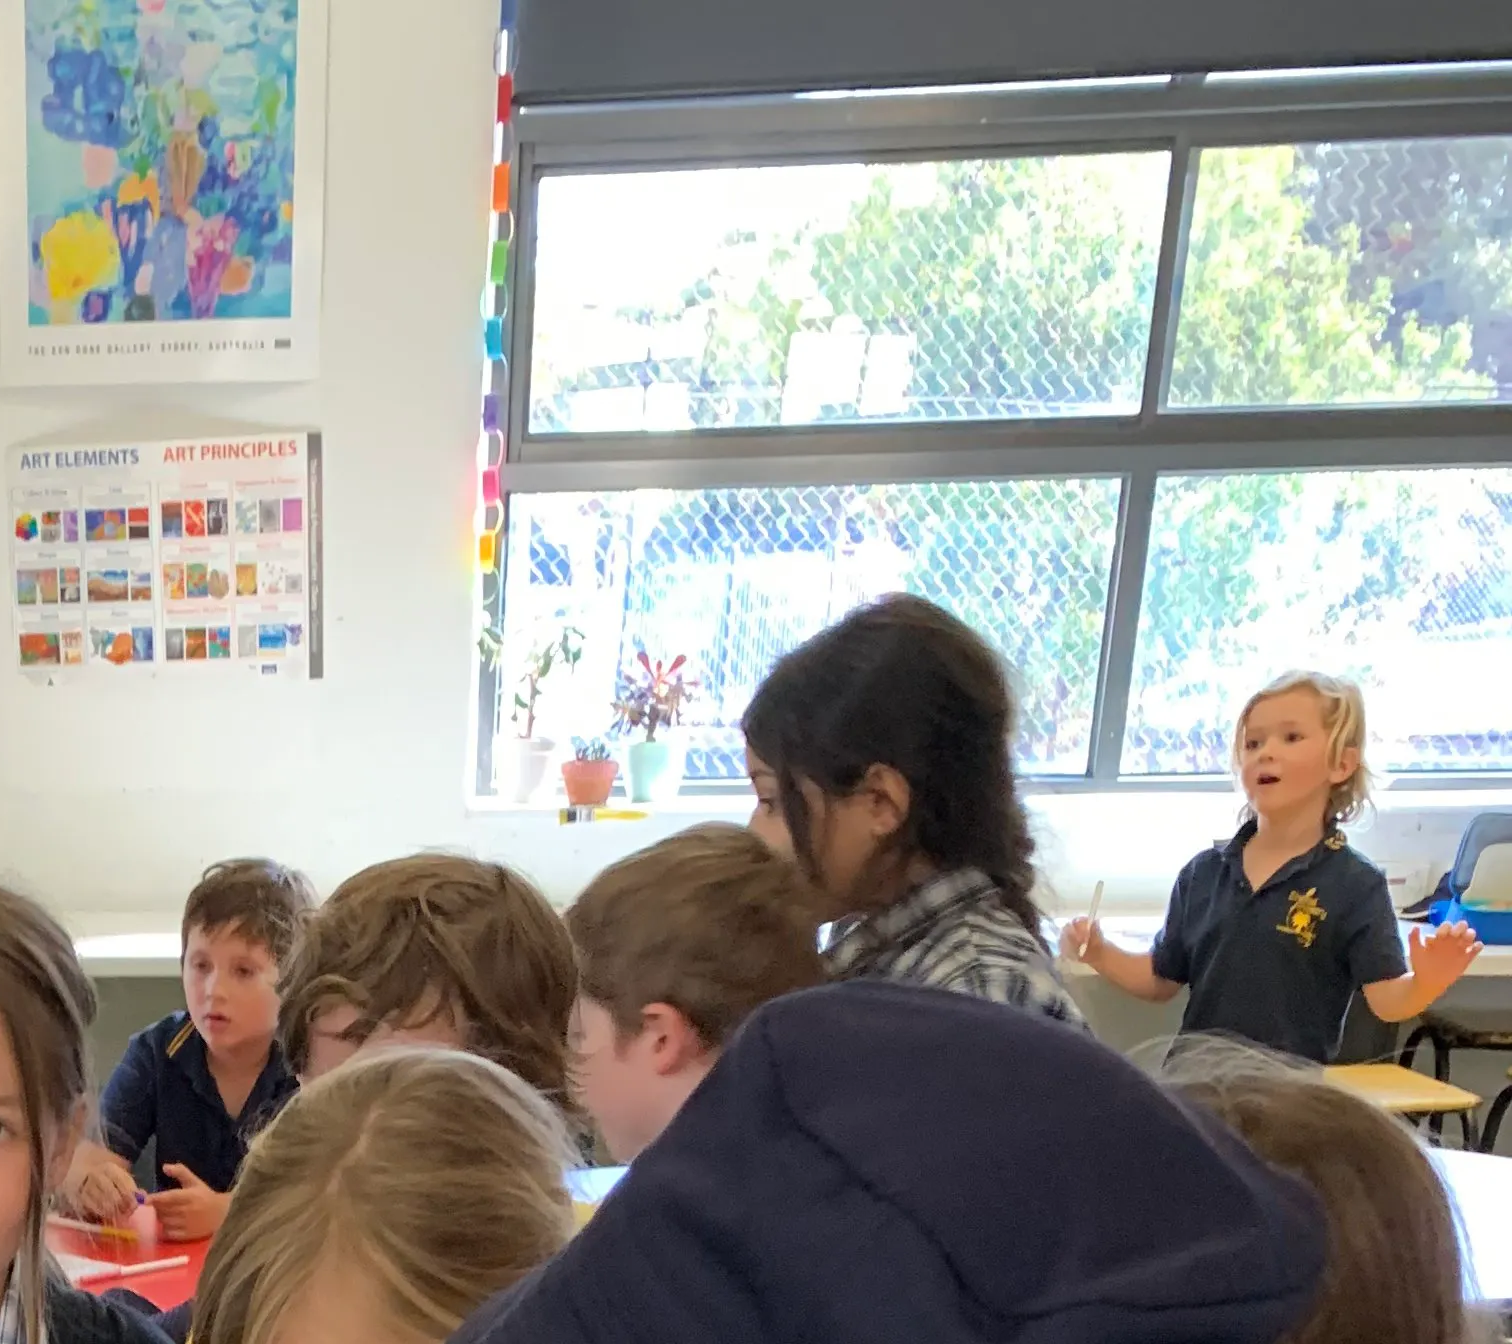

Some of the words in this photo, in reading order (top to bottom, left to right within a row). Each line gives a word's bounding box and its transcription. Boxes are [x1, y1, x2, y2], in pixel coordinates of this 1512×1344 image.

[20, 451, 51, 470] ART
[55, 448, 140, 469] ELEMENTS
[163, 445, 196, 463] ART
[200, 439, 298, 461] PRINCIPLES
